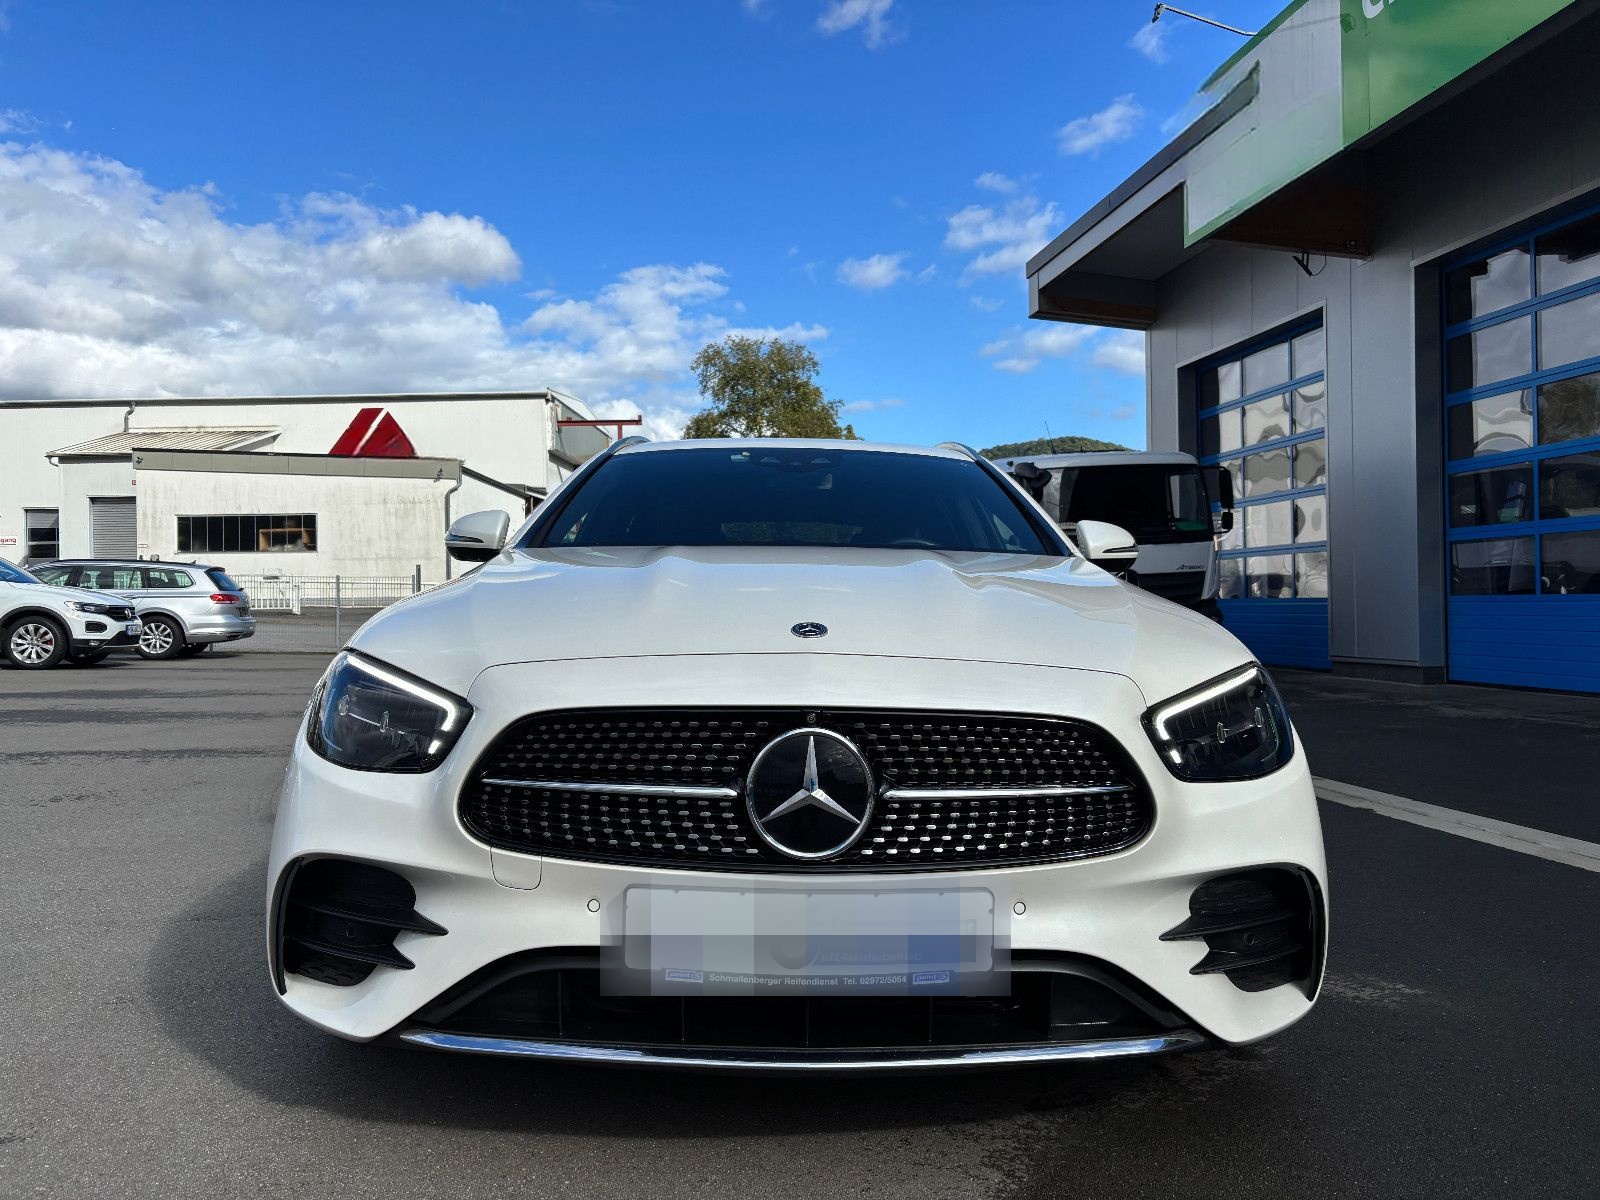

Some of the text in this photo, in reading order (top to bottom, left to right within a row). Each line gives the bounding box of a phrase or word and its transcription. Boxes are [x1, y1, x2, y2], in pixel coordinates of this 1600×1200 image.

[709, 974, 782, 985] Schmallenberger
[784, 977, 838, 985] Reifendienst
[843, 977, 857, 985] Tel.
